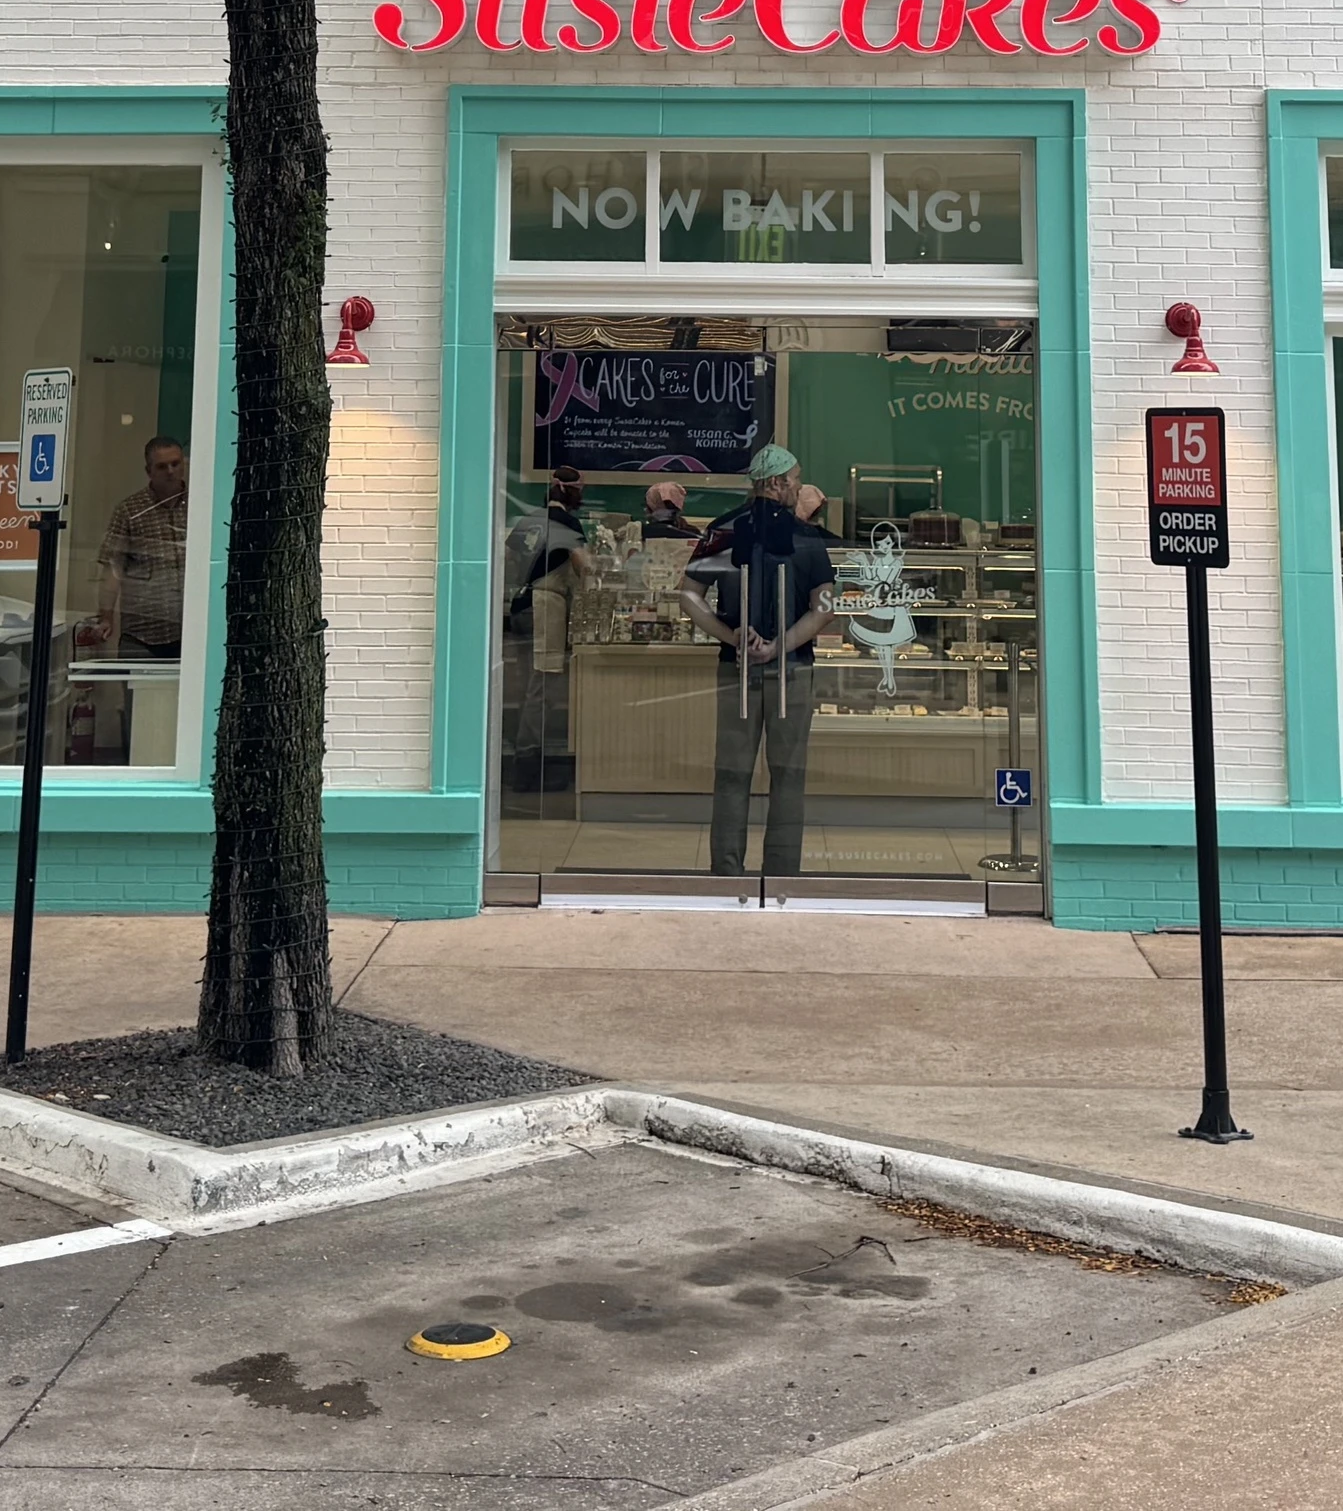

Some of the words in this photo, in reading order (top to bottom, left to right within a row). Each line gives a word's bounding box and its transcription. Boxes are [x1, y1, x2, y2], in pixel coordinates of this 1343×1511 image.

[552, 187, 703, 233] NOW
[722, 188, 983, 234] BAKING!
[578, 357, 657, 407] CAKES
[659, 367, 680, 384] for
[693, 359, 757, 411] CURE
[26, 383, 68, 401] RESERVED
[669, 382, 690, 394] the
[887, 397, 907, 418] IT
[912, 391, 990, 411] COMES
[995, 396, 1034, 421] FRO
[27, 407, 64, 425] PARKING
[1164, 422, 1207, 464] 15
[1162, 468, 1211, 482] MINUTE
[1159, 484, 1216, 499] PARKING
[1159, 512, 1217, 531] ORDER
[1159, 535, 1219, 554] PICKUP
[817, 582, 937, 613] SusieCakes
